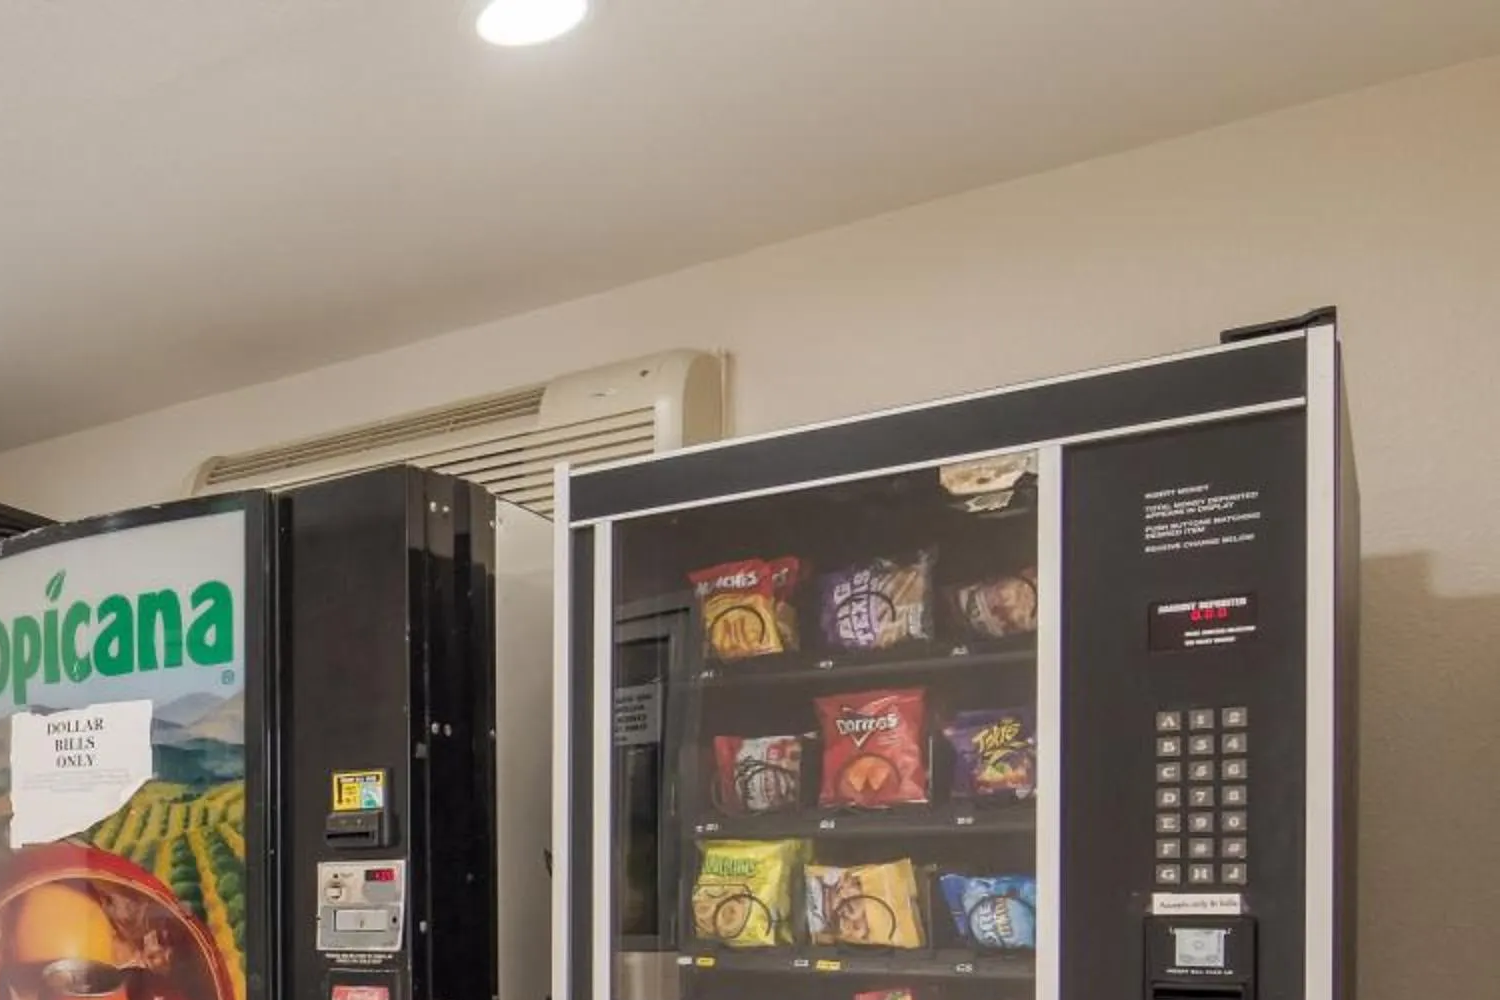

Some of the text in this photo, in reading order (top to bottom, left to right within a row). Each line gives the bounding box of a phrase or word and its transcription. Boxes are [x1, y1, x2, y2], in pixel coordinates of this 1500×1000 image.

[47, 717, 105, 736] DOLLAR
[54, 735, 96, 752] BILLS
[55, 753, 96, 769] ONLY
